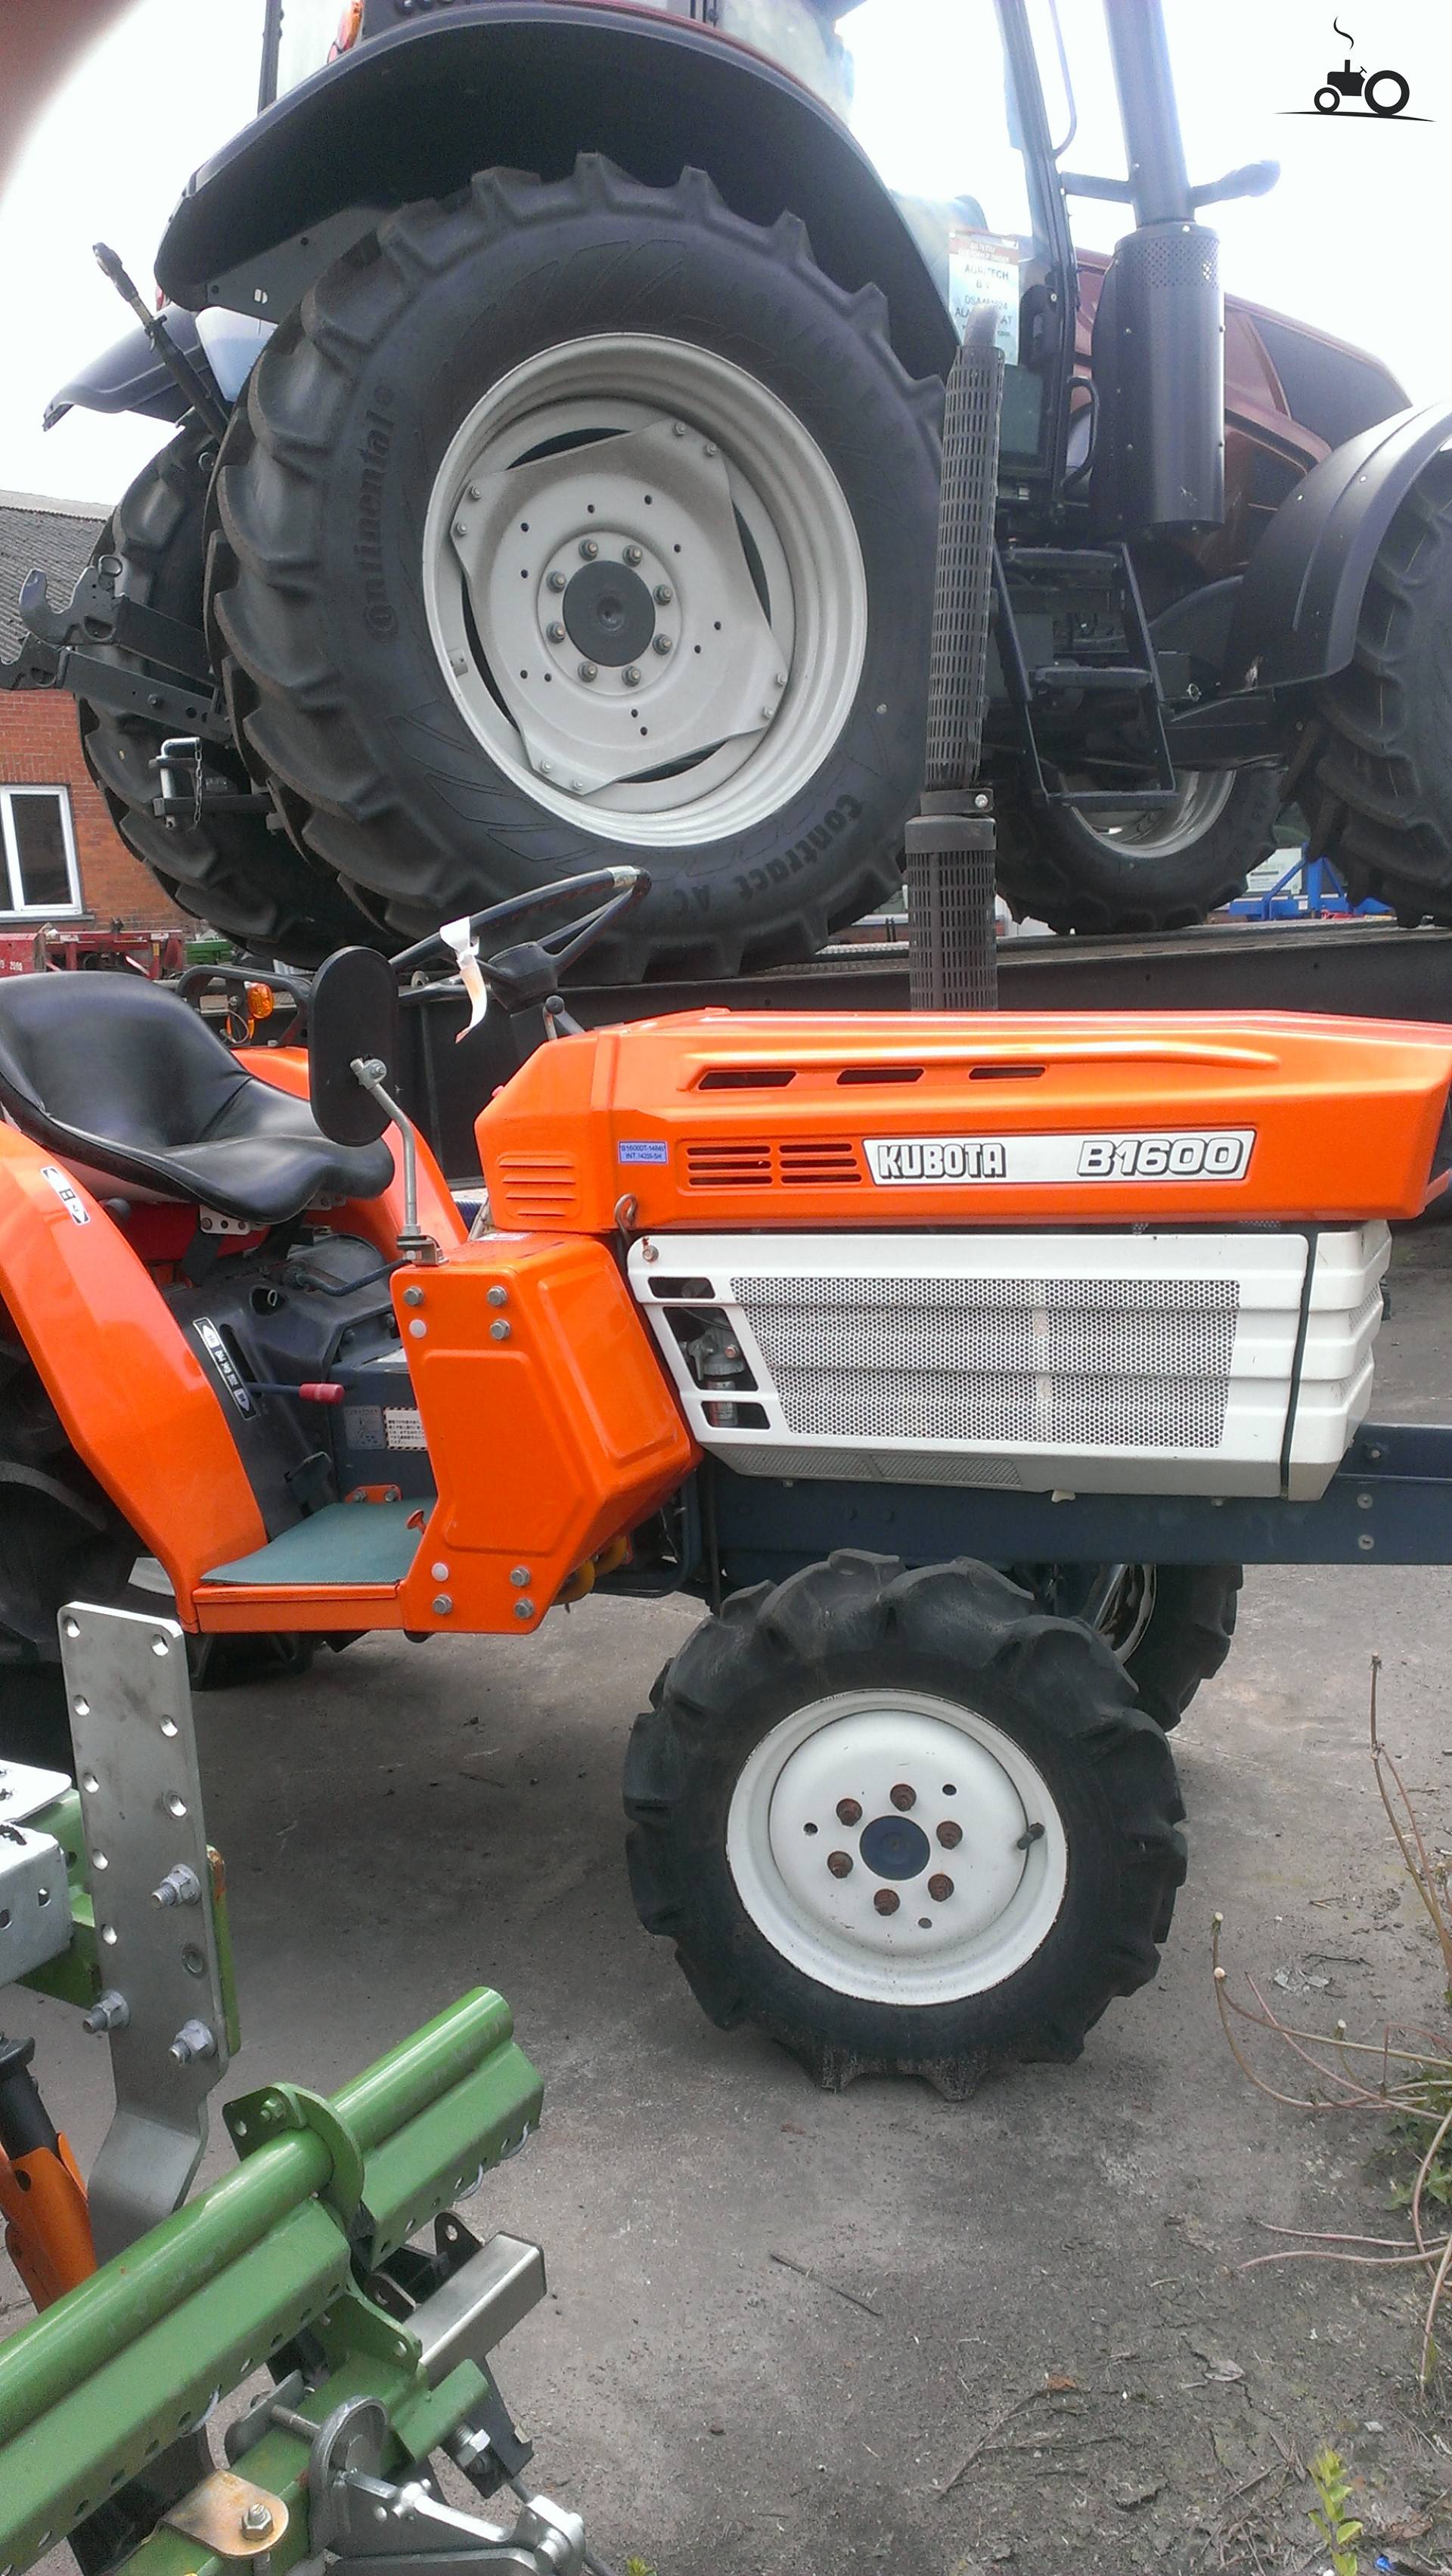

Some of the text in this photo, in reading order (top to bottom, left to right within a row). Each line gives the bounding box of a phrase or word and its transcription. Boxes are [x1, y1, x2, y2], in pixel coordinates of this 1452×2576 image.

[672, 794, 863, 916] Contract AC
[877, 1136, 1245, 1179] KUBOTA B1600
